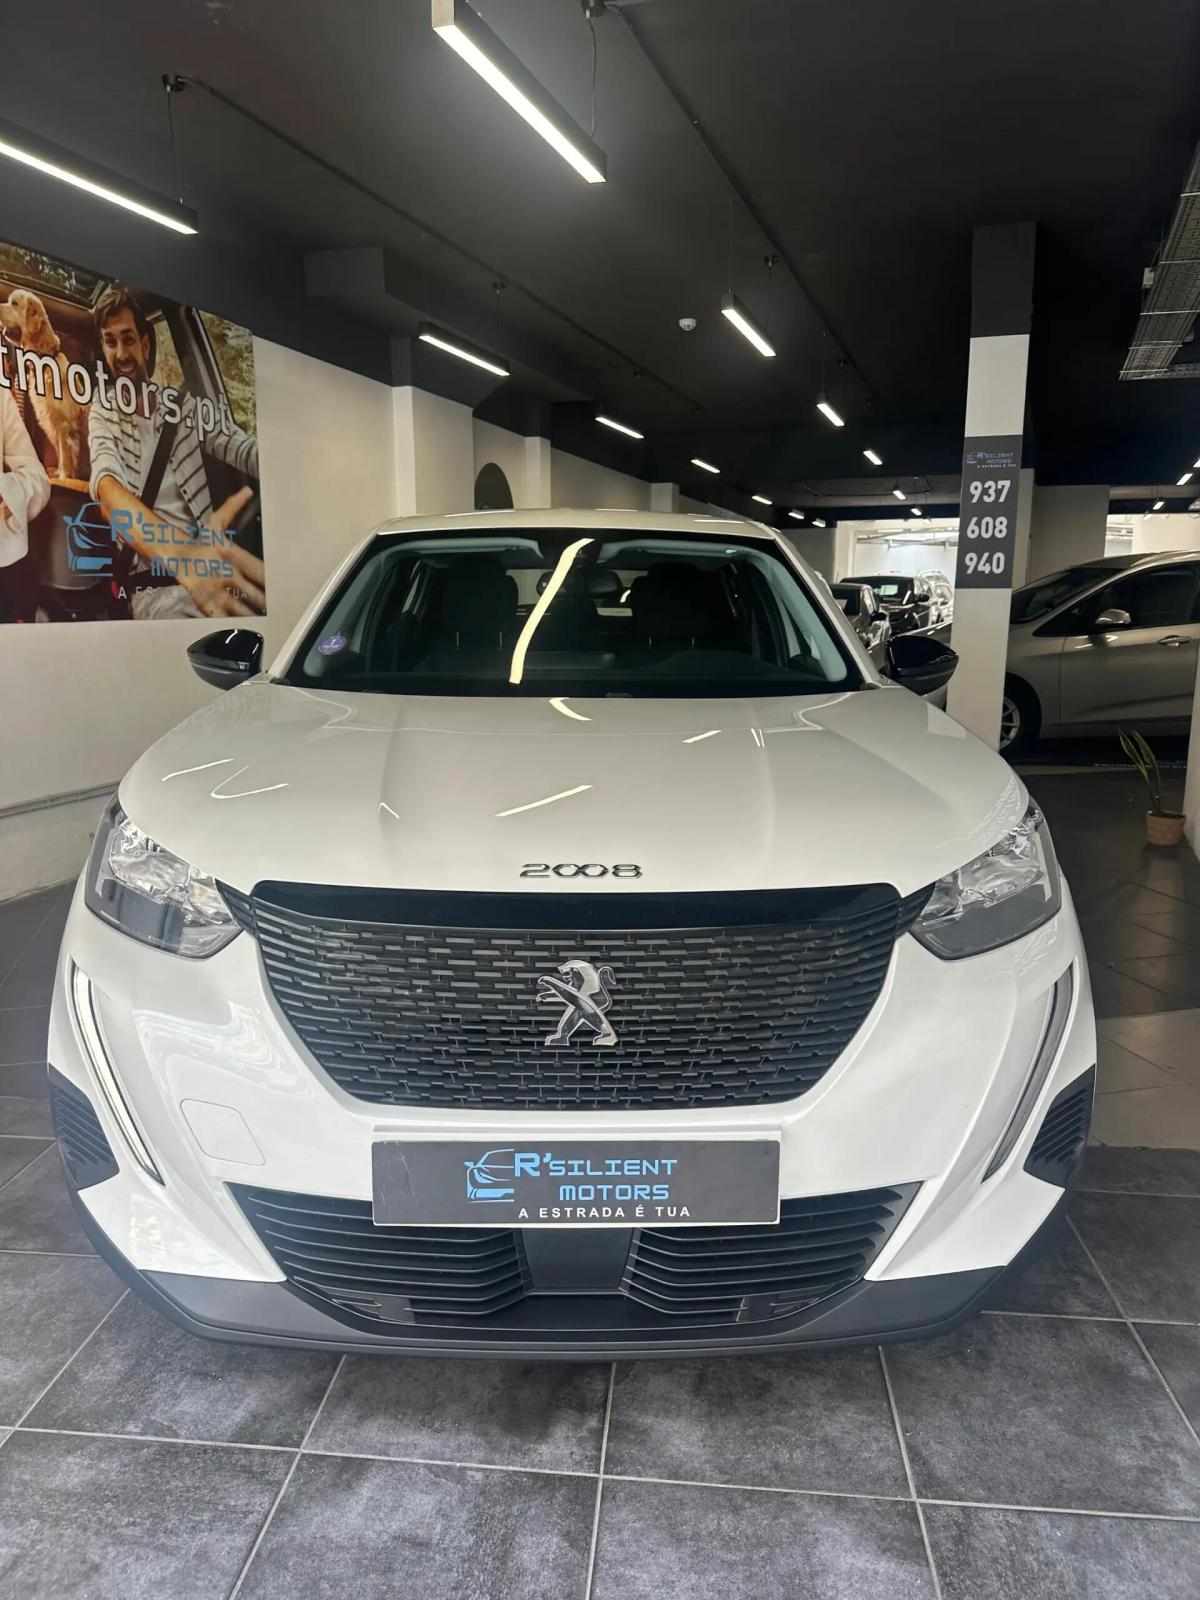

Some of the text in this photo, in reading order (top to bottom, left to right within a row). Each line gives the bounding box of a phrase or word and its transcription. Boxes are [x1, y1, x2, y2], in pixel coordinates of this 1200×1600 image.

[969, 480, 1011, 503] 937
[111, 510, 237, 548] R'SILIENT
[966, 516, 1008, 539] 608
[151, 556, 234, 578] MOTORS
[964, 552, 1005, 574] 940
[519, 863, 643, 879] 2008
[514, 1152, 678, 1176] R'SILIENT
[559, 1184, 670, 1201] MOTORS
[518, 1204, 691, 1219] A ESTRADA É TUA
